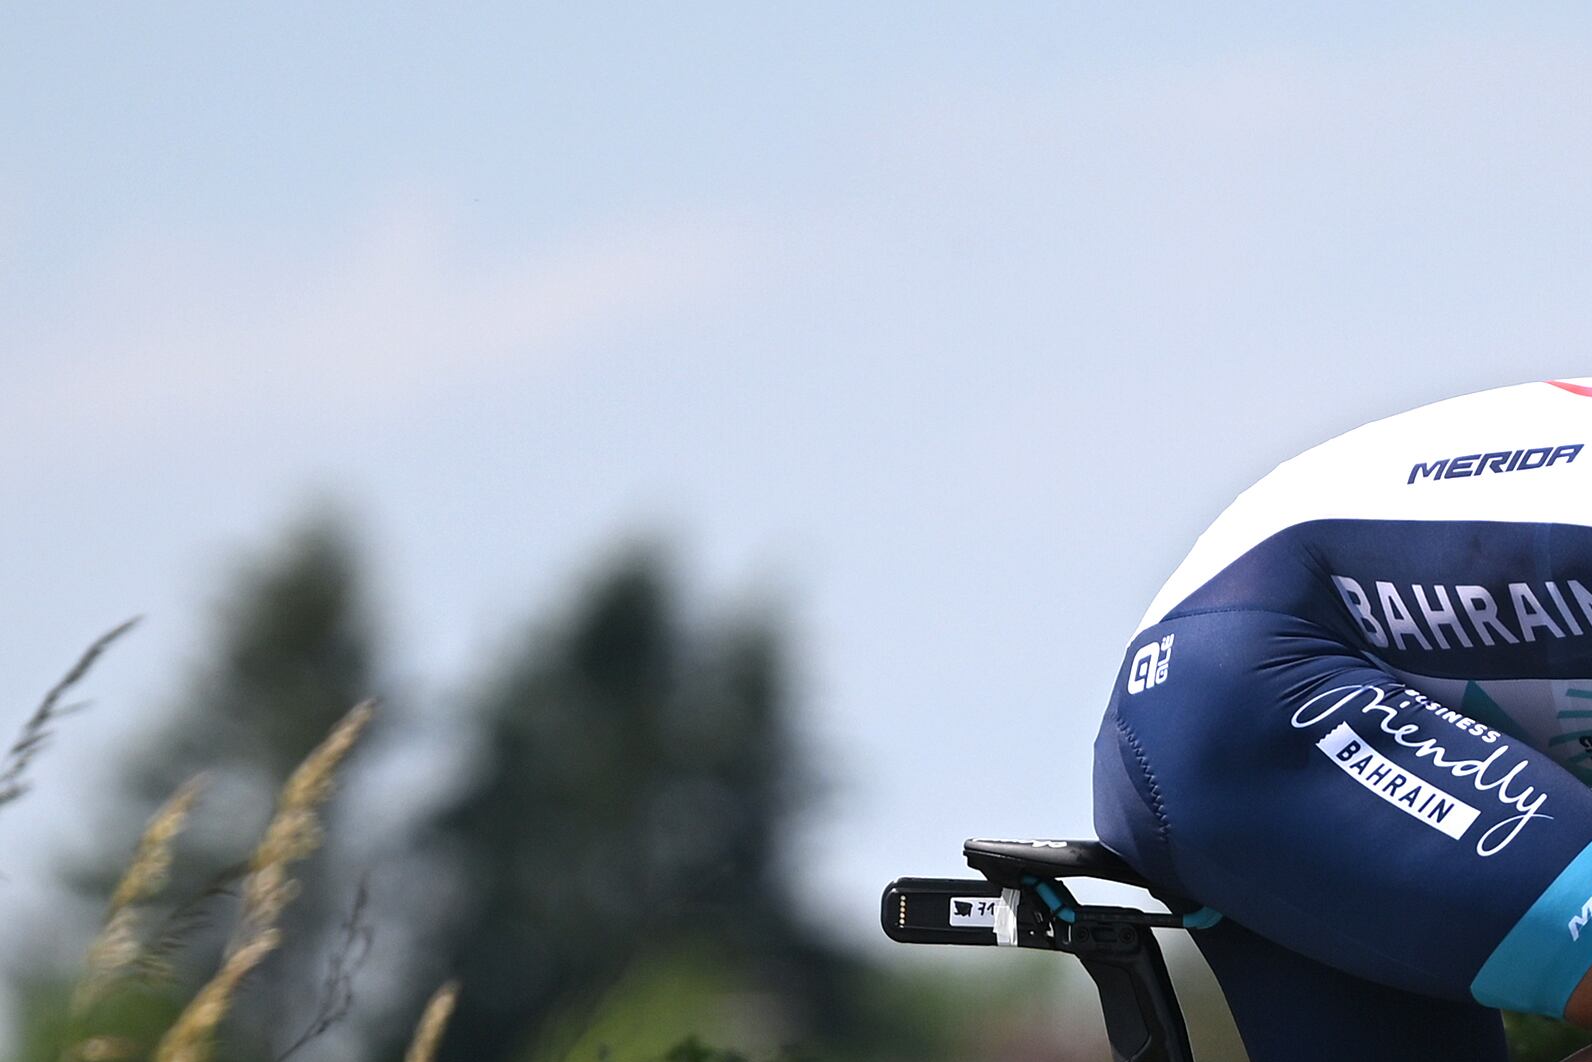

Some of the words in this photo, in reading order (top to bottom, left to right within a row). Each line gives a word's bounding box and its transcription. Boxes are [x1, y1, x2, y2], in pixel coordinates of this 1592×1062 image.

[1407, 443, 1585, 485] MERIDA
[1404, 688, 1502, 744] BUSINESS
[1335, 739, 1456, 824] BAHRAIN
